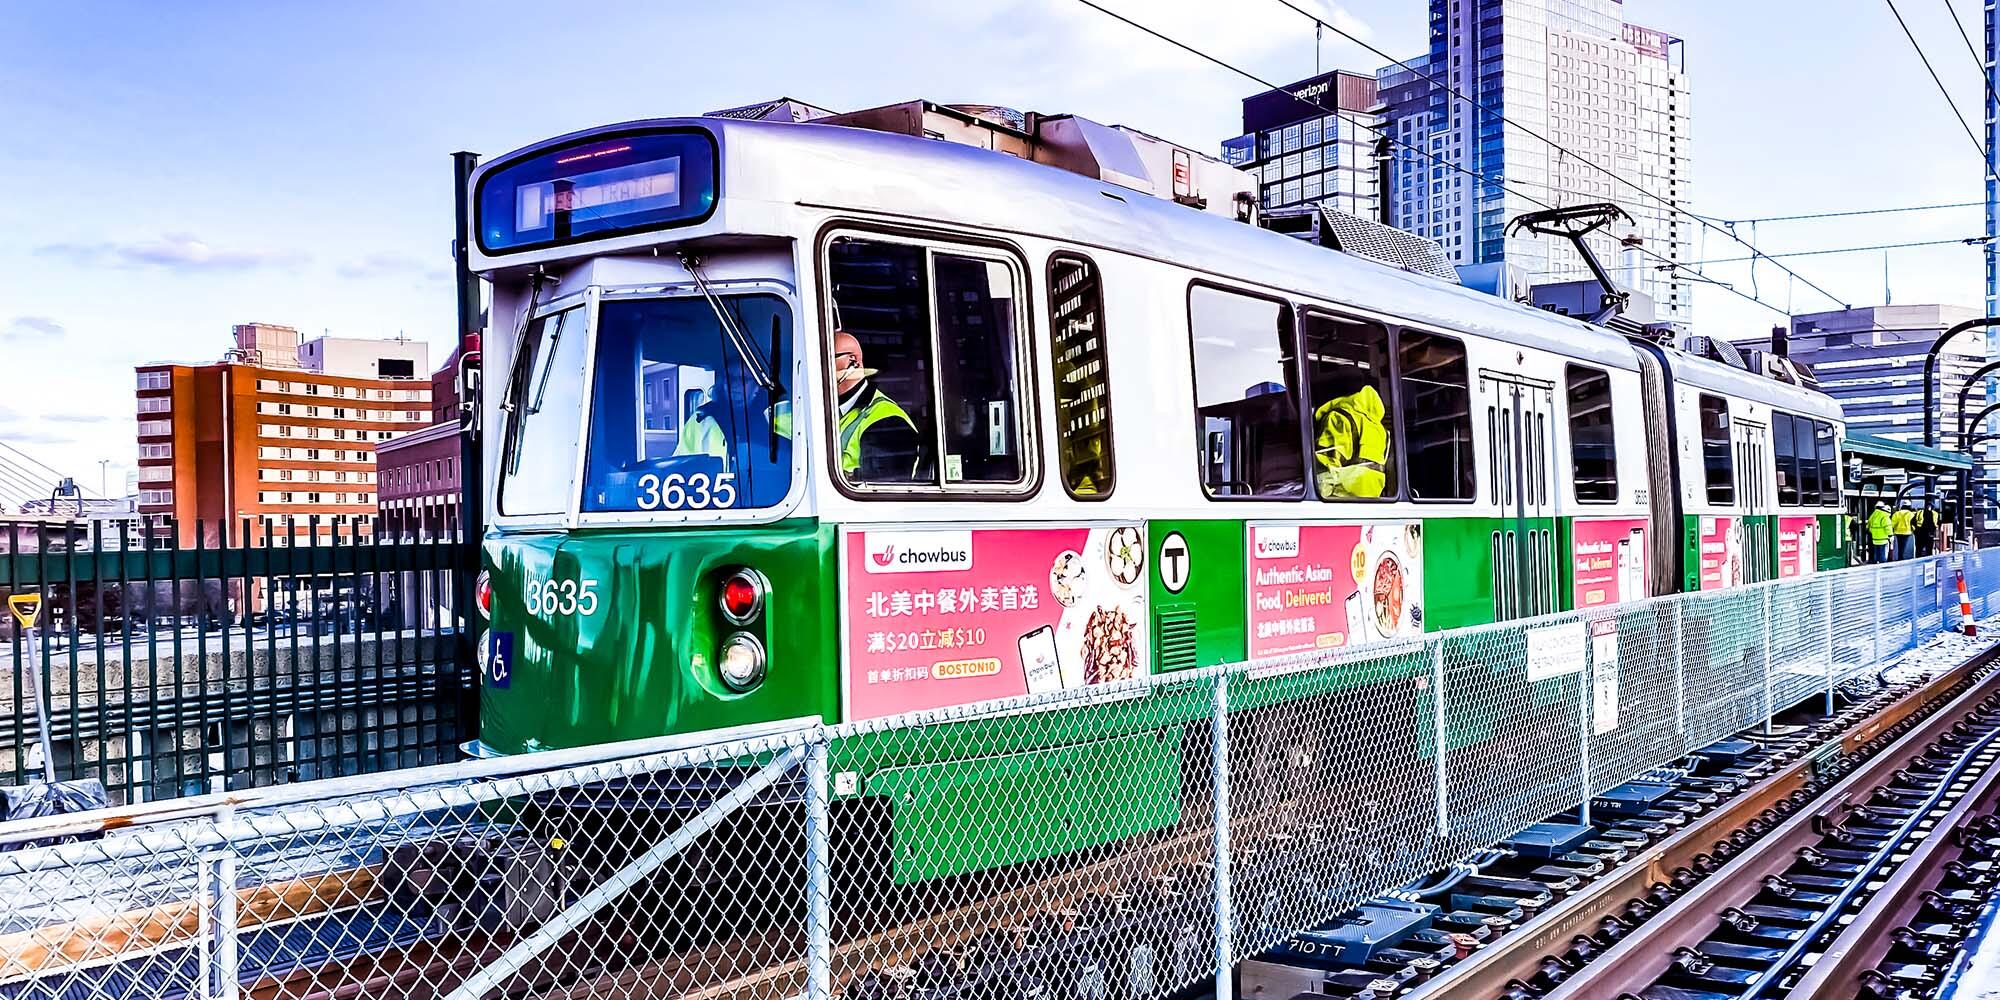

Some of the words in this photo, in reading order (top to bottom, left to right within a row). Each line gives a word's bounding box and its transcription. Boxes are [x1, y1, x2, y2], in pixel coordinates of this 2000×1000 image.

[1293, 82, 1329, 101] verizon
[636, 472, 736, 510] 3635
[899, 547, 967, 565] chowbus
[1268, 541, 1297, 552] chowbus
[1165, 548, 1185, 583] T
[1256, 566, 1304, 587] Authentic
[1305, 563, 1333, 582] Asian
[526, 579, 598, 616] 3635
[865, 585, 1039, 618] 北美中餐外卖首选
[1256, 590, 1284, 612] Food,
[1285, 586, 1332, 608] Delivered
[866, 628, 986, 654] 满$20立减$10
[867, 666, 929, 684] 首单折扣码
[939, 662, 995, 676] BOSTON10
[1289, 939, 1316, 954] 710
[1320, 943, 1346, 957] TT
